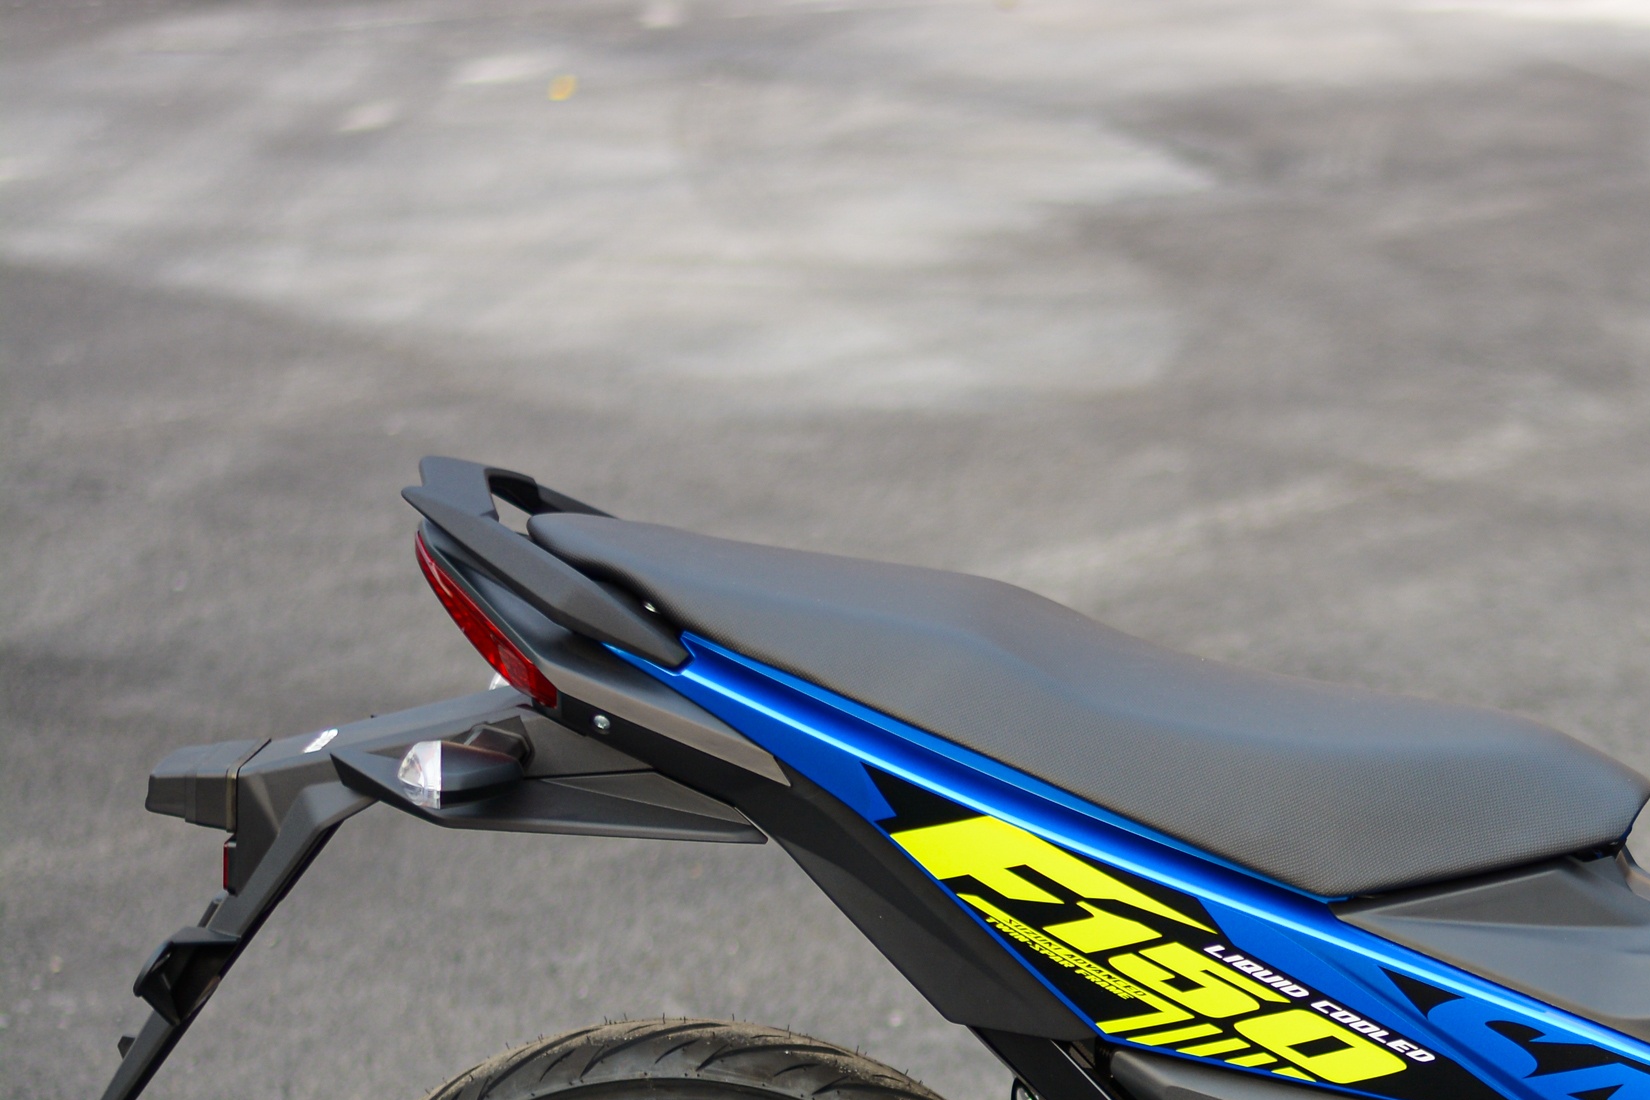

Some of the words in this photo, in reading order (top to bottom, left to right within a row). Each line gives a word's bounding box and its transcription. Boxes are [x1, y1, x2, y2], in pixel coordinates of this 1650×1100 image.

[984, 915, 1077, 969] TWIN-SPAR
[1074, 968, 1136, 1001] FRAME
[1003, 918, 1064, 952] SUZUKI
[1064, 953, 1148, 998] ADVANCED
[1203, 943, 1311, 999] LIQUID
[1310, 998, 1437, 1064] COOLED
